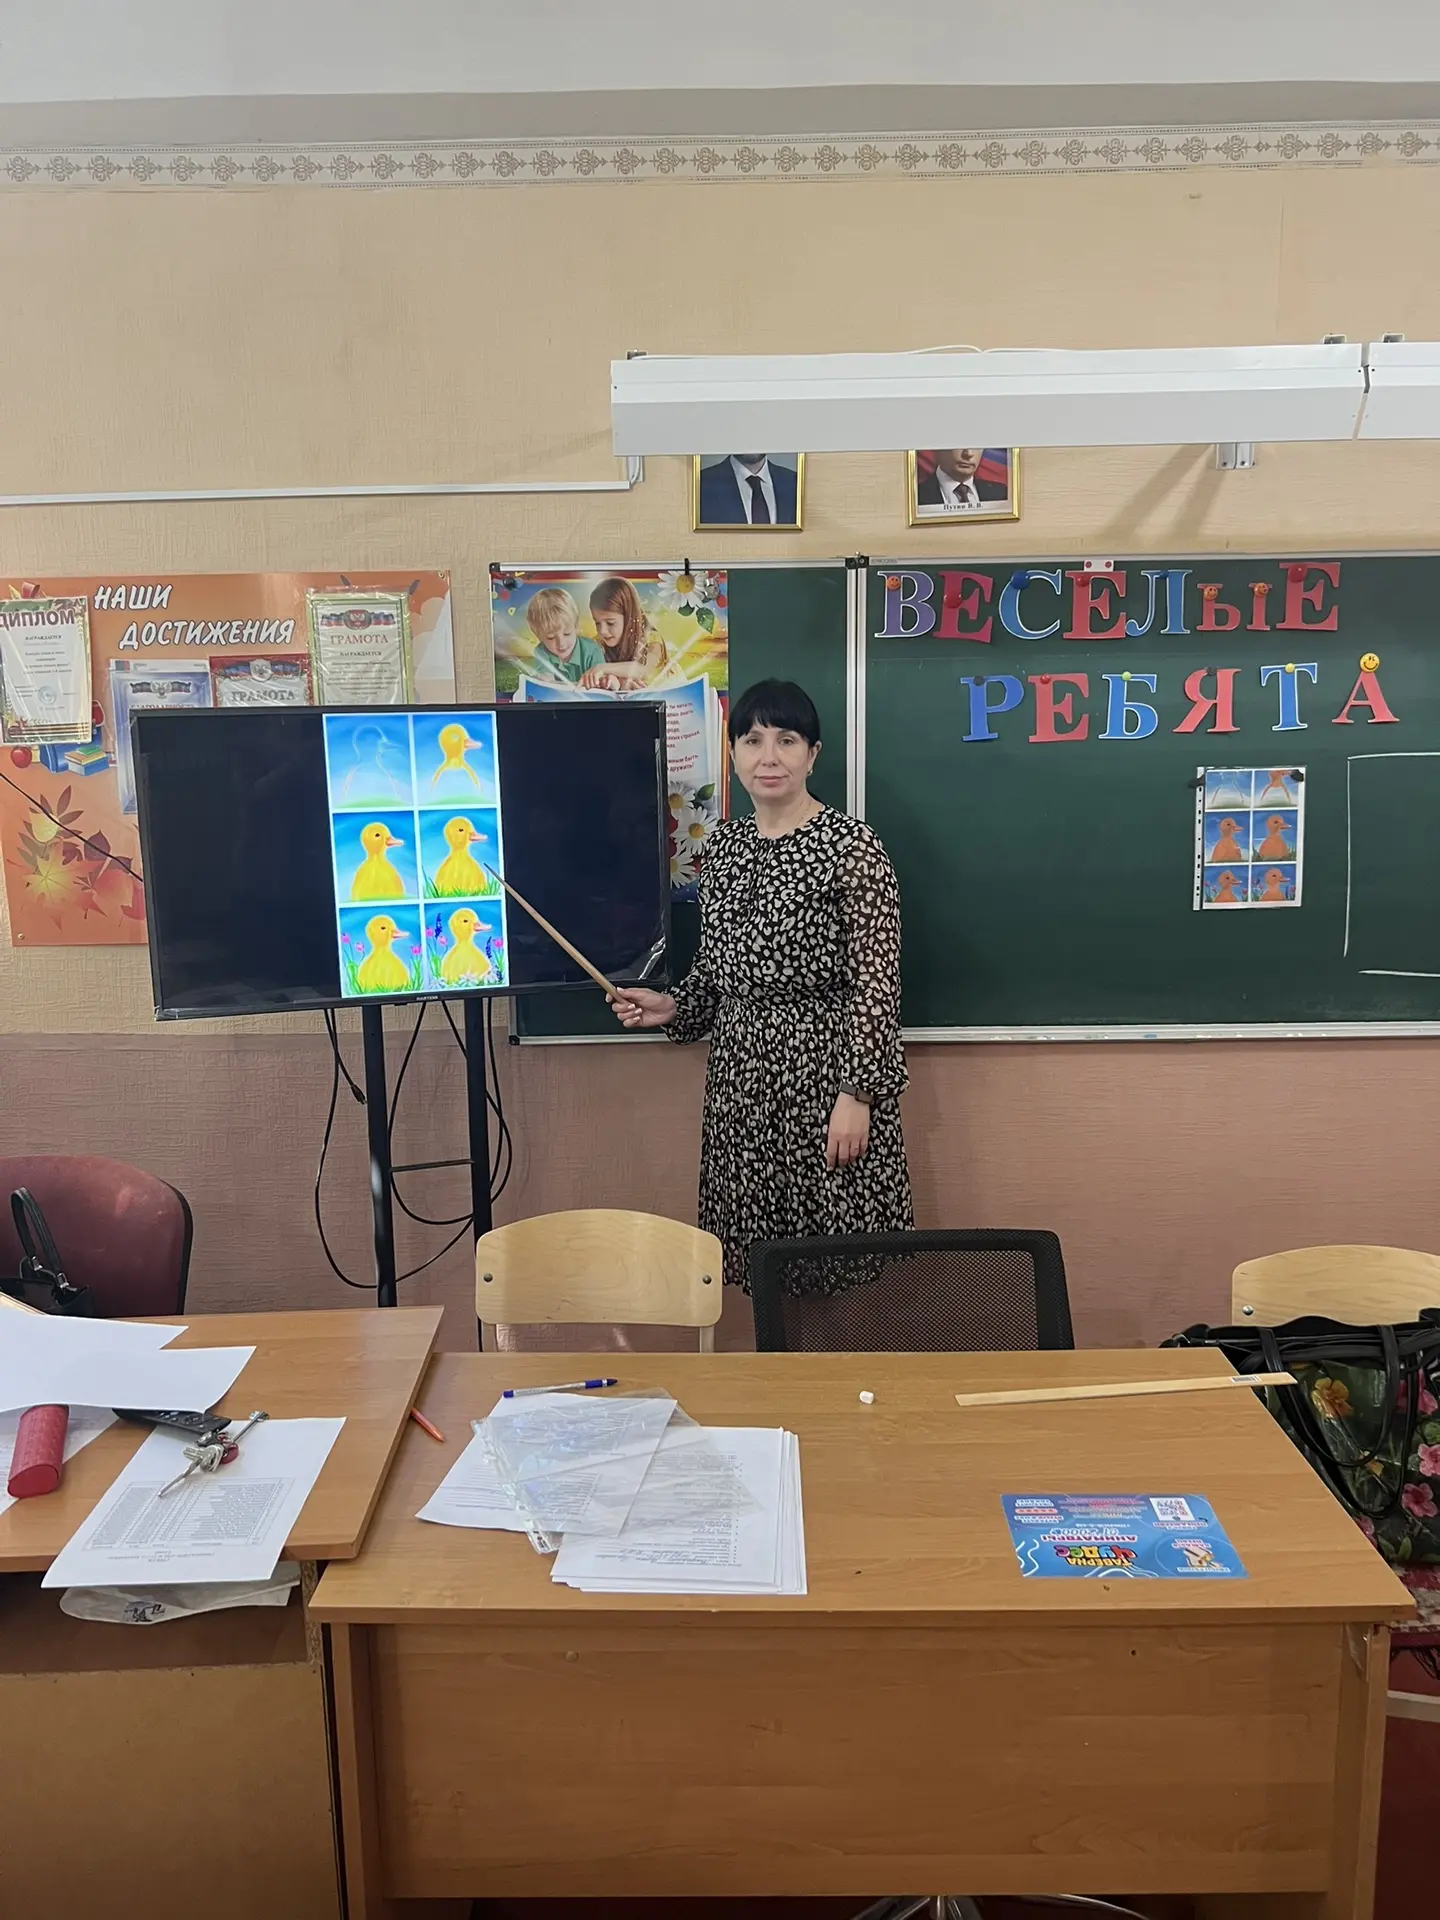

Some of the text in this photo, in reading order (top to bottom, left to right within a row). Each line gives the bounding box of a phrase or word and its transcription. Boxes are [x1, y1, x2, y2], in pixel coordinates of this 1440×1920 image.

[943, 503, 966, 512] Путин
[94, 584, 173, 610] НАШИ
[118, 618, 296, 651] ДОСТИЖЕНИЯ
[330, 634, 389, 645] ГРАМОТА
[231, 690, 296, 703] ГРАМОТА
[960, 660, 1399, 743] РЕБЯТА
[1041, 1534, 1137, 1543] АНИМАТОРЫ
[1065, 1556, 1132, 1567] ТАВЕРНА
